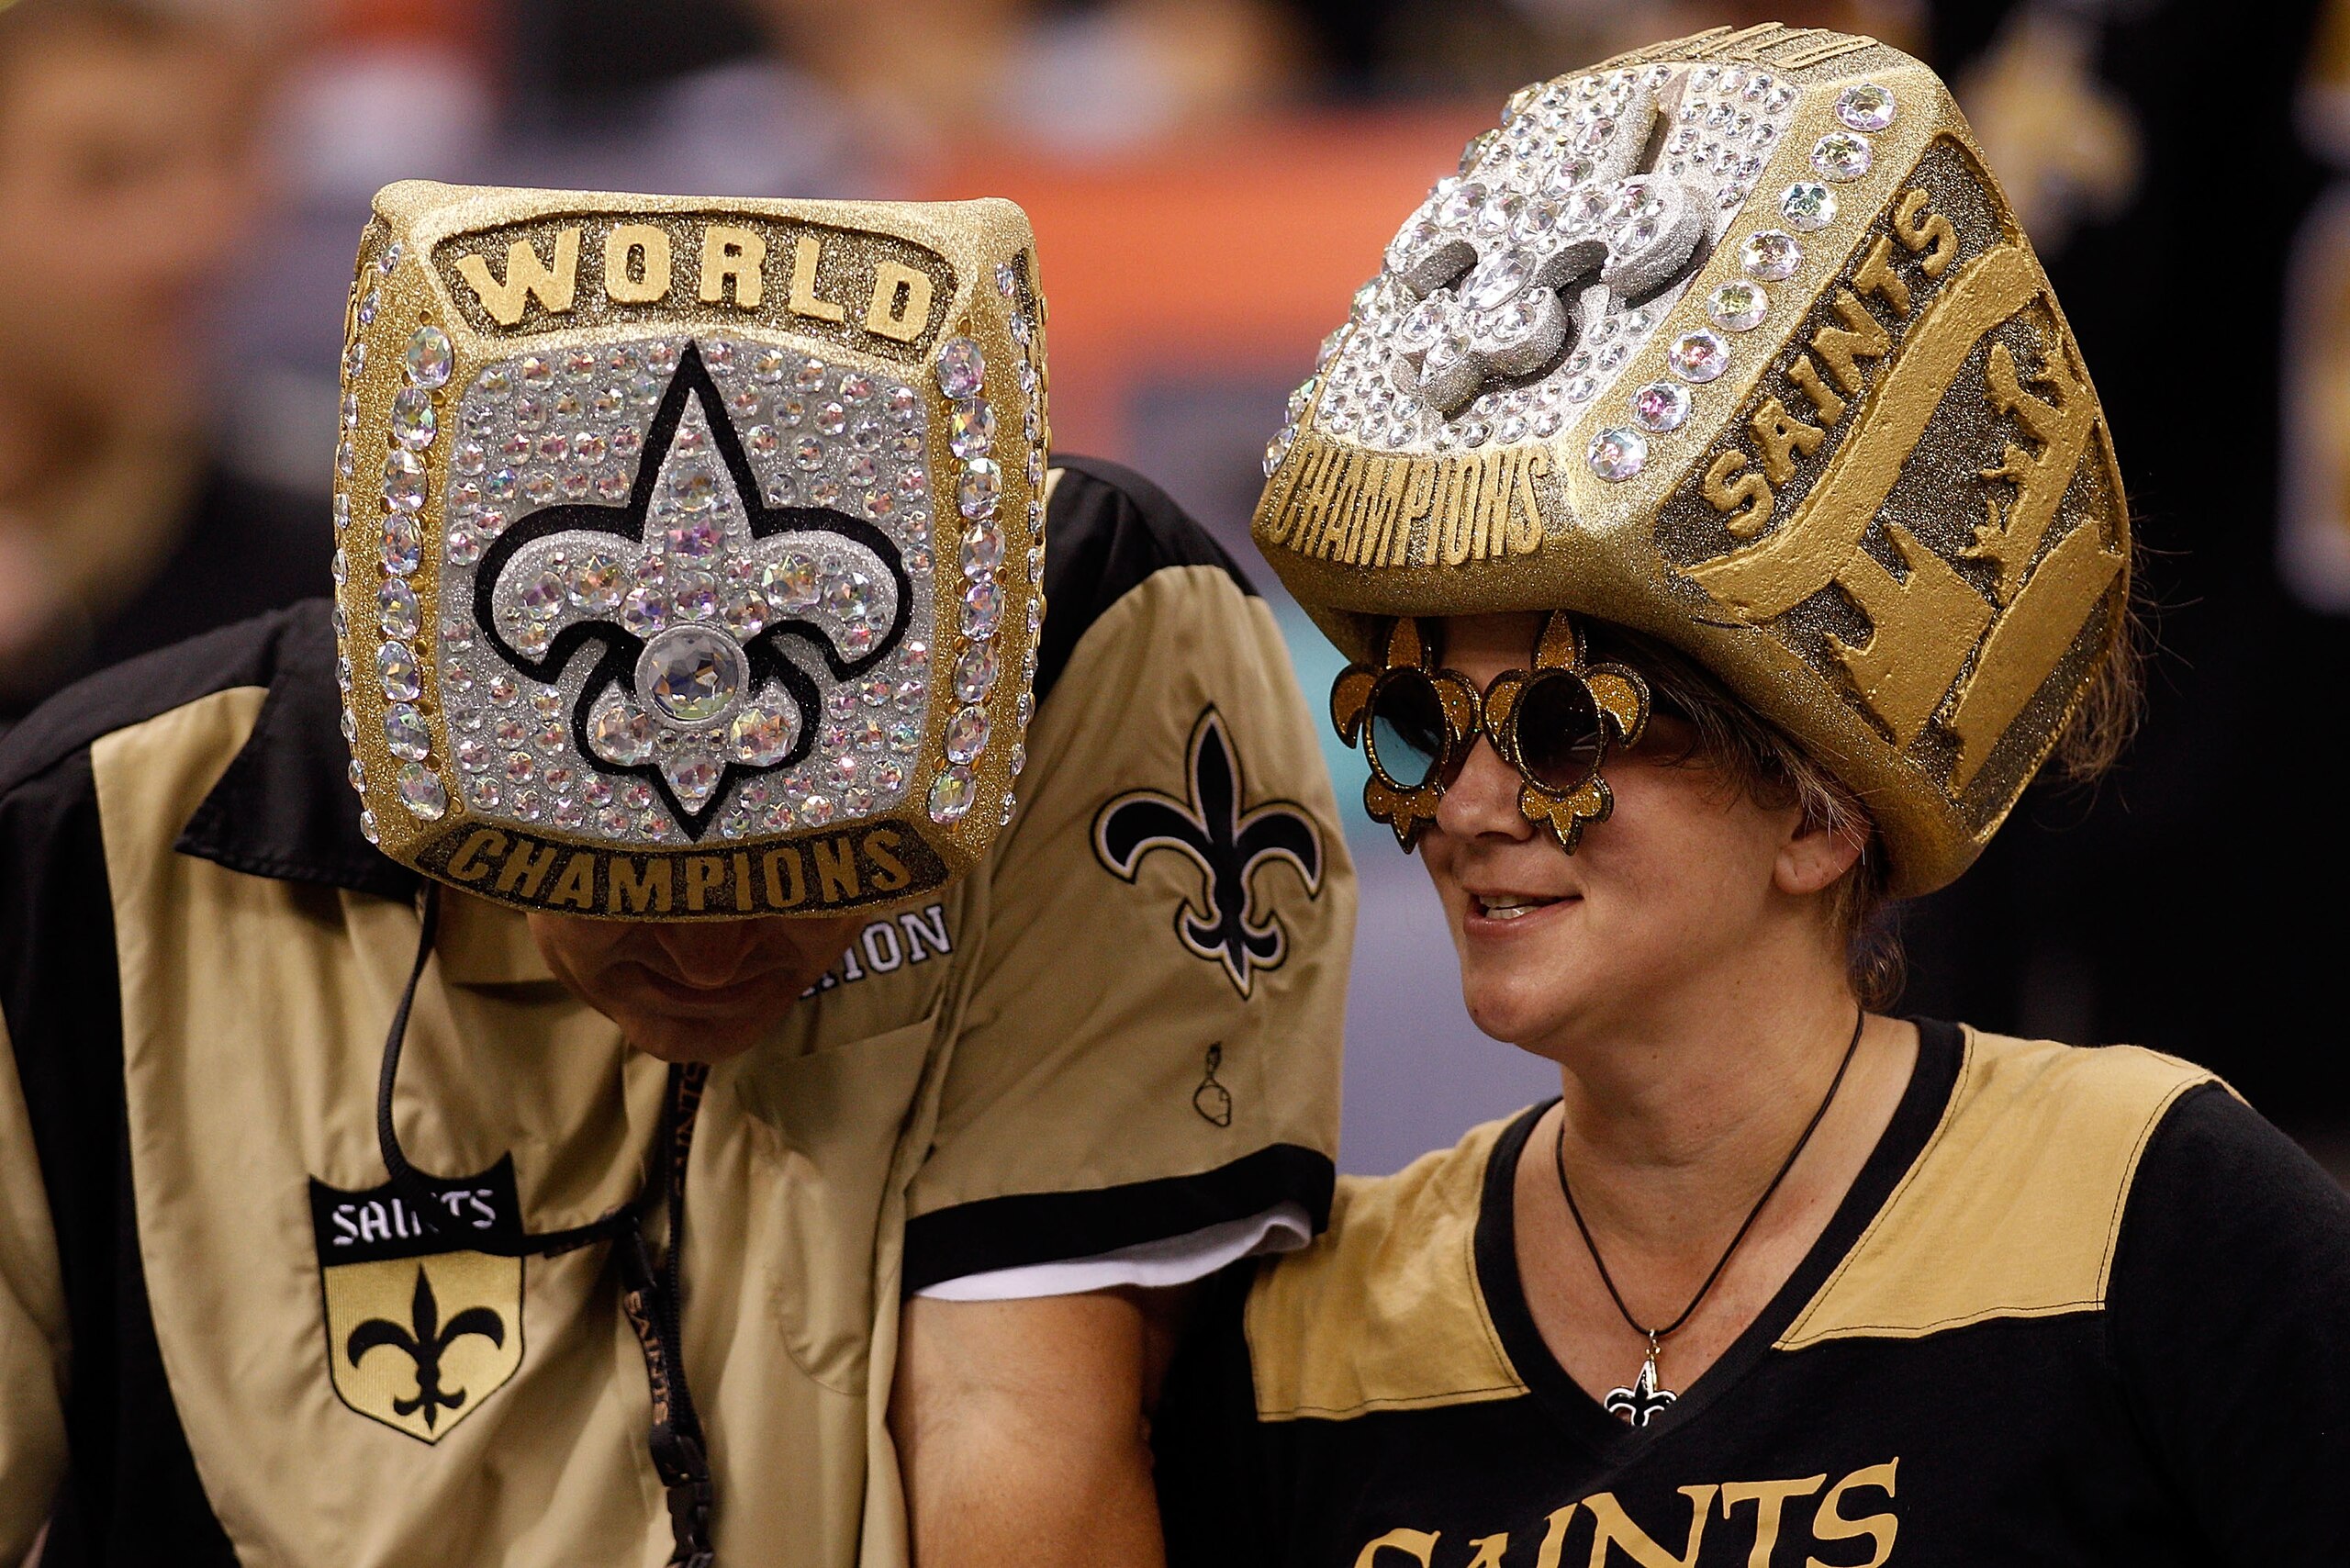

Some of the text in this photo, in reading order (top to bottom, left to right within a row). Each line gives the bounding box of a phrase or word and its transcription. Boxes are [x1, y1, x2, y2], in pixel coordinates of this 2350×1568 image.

[455, 224, 934, 342] WORLD
[1702, 187, 1959, 538] SAINTS
[1270, 445, 1550, 568] CHAMPIONS
[446, 828, 911, 913] CHAMPIONS
